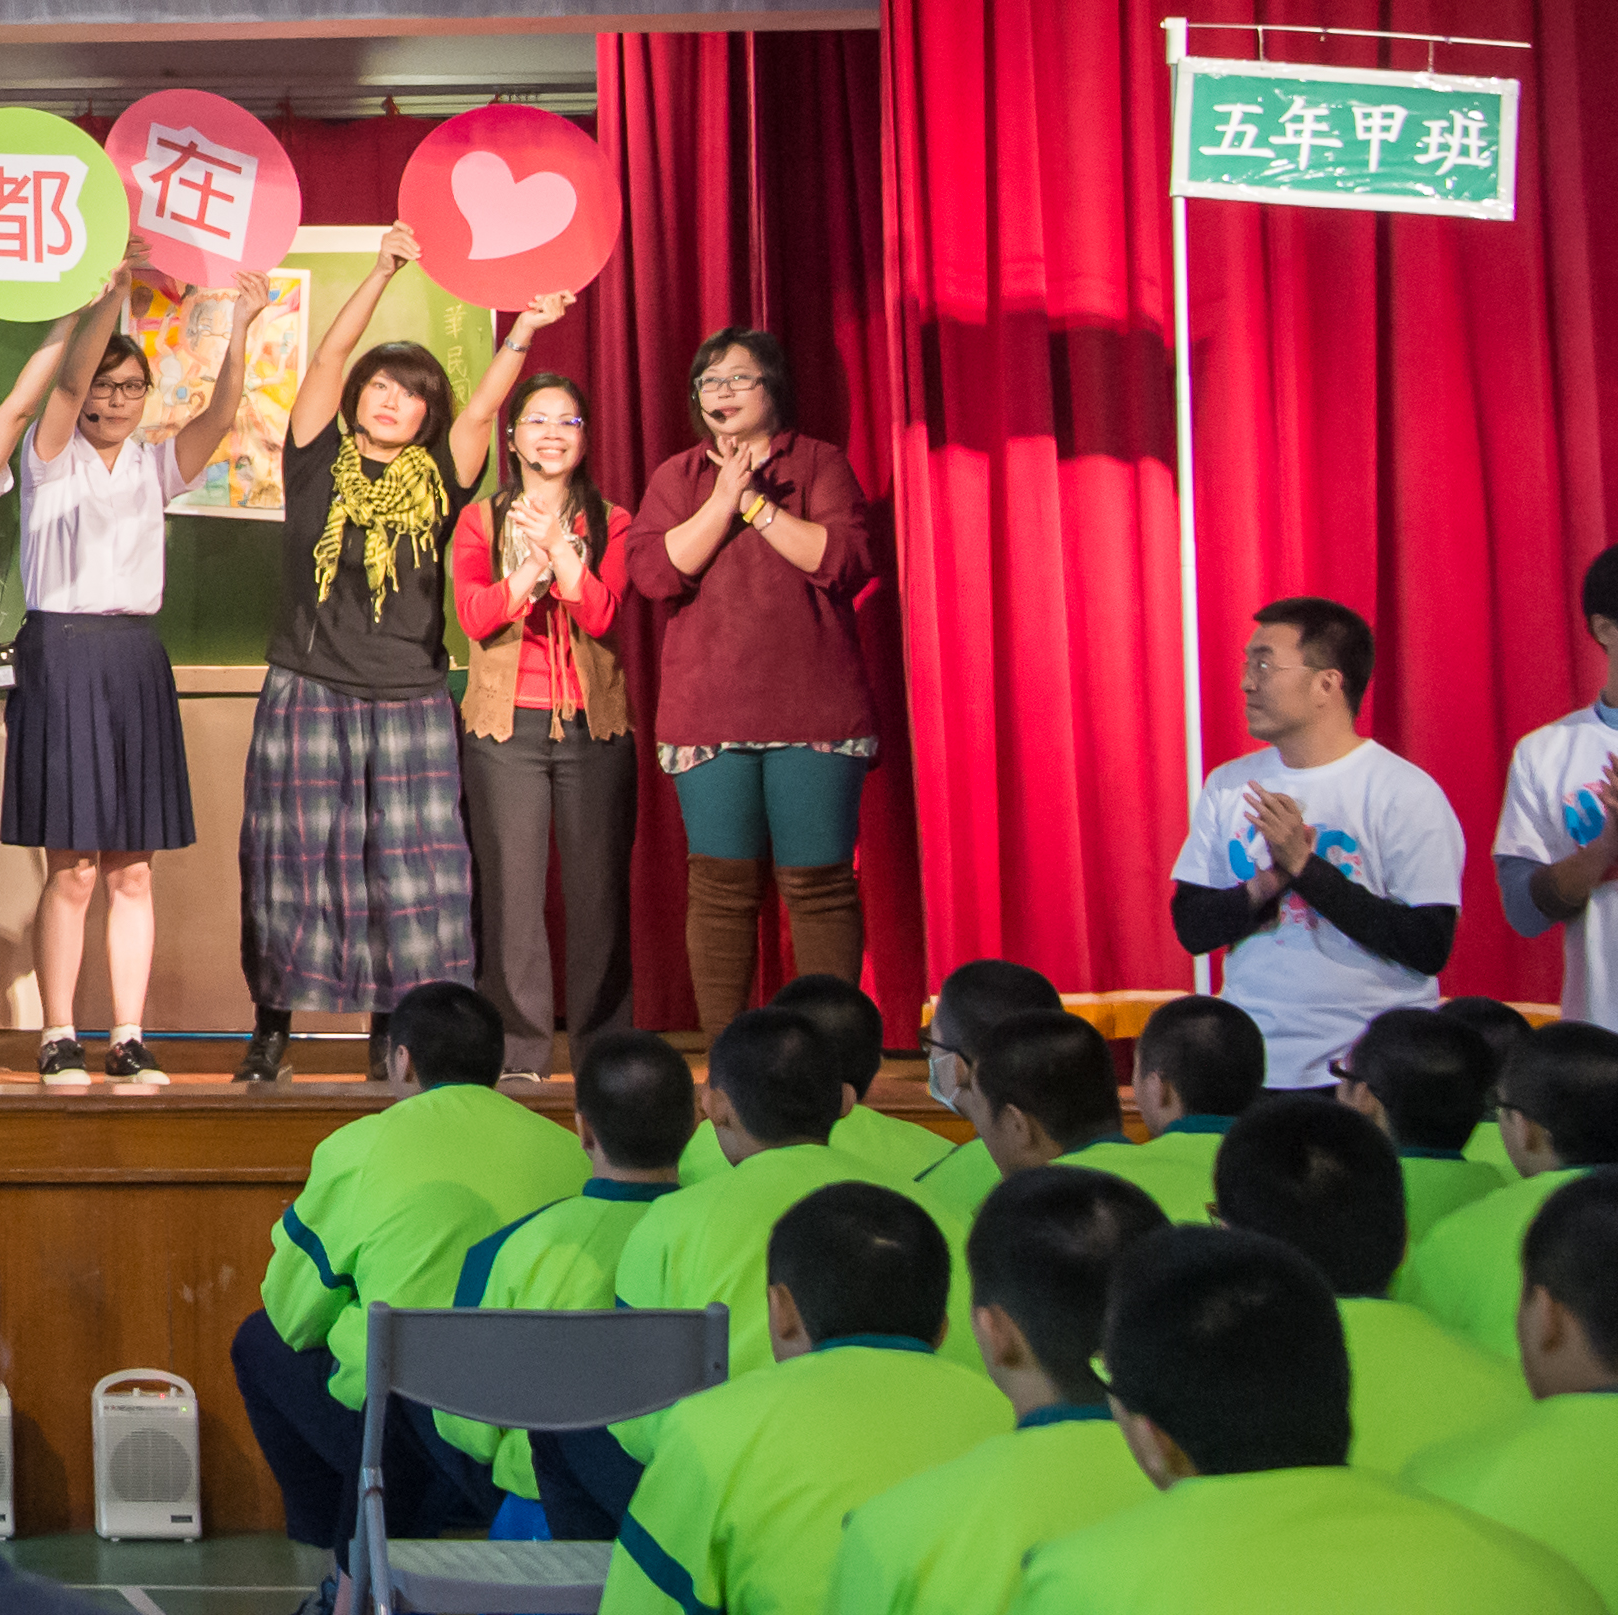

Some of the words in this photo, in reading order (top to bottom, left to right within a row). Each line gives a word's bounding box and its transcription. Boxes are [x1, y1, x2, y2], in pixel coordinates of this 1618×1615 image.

[1199, 95, 1492, 176] 五年甲班
[149, 136, 244, 240] 在
